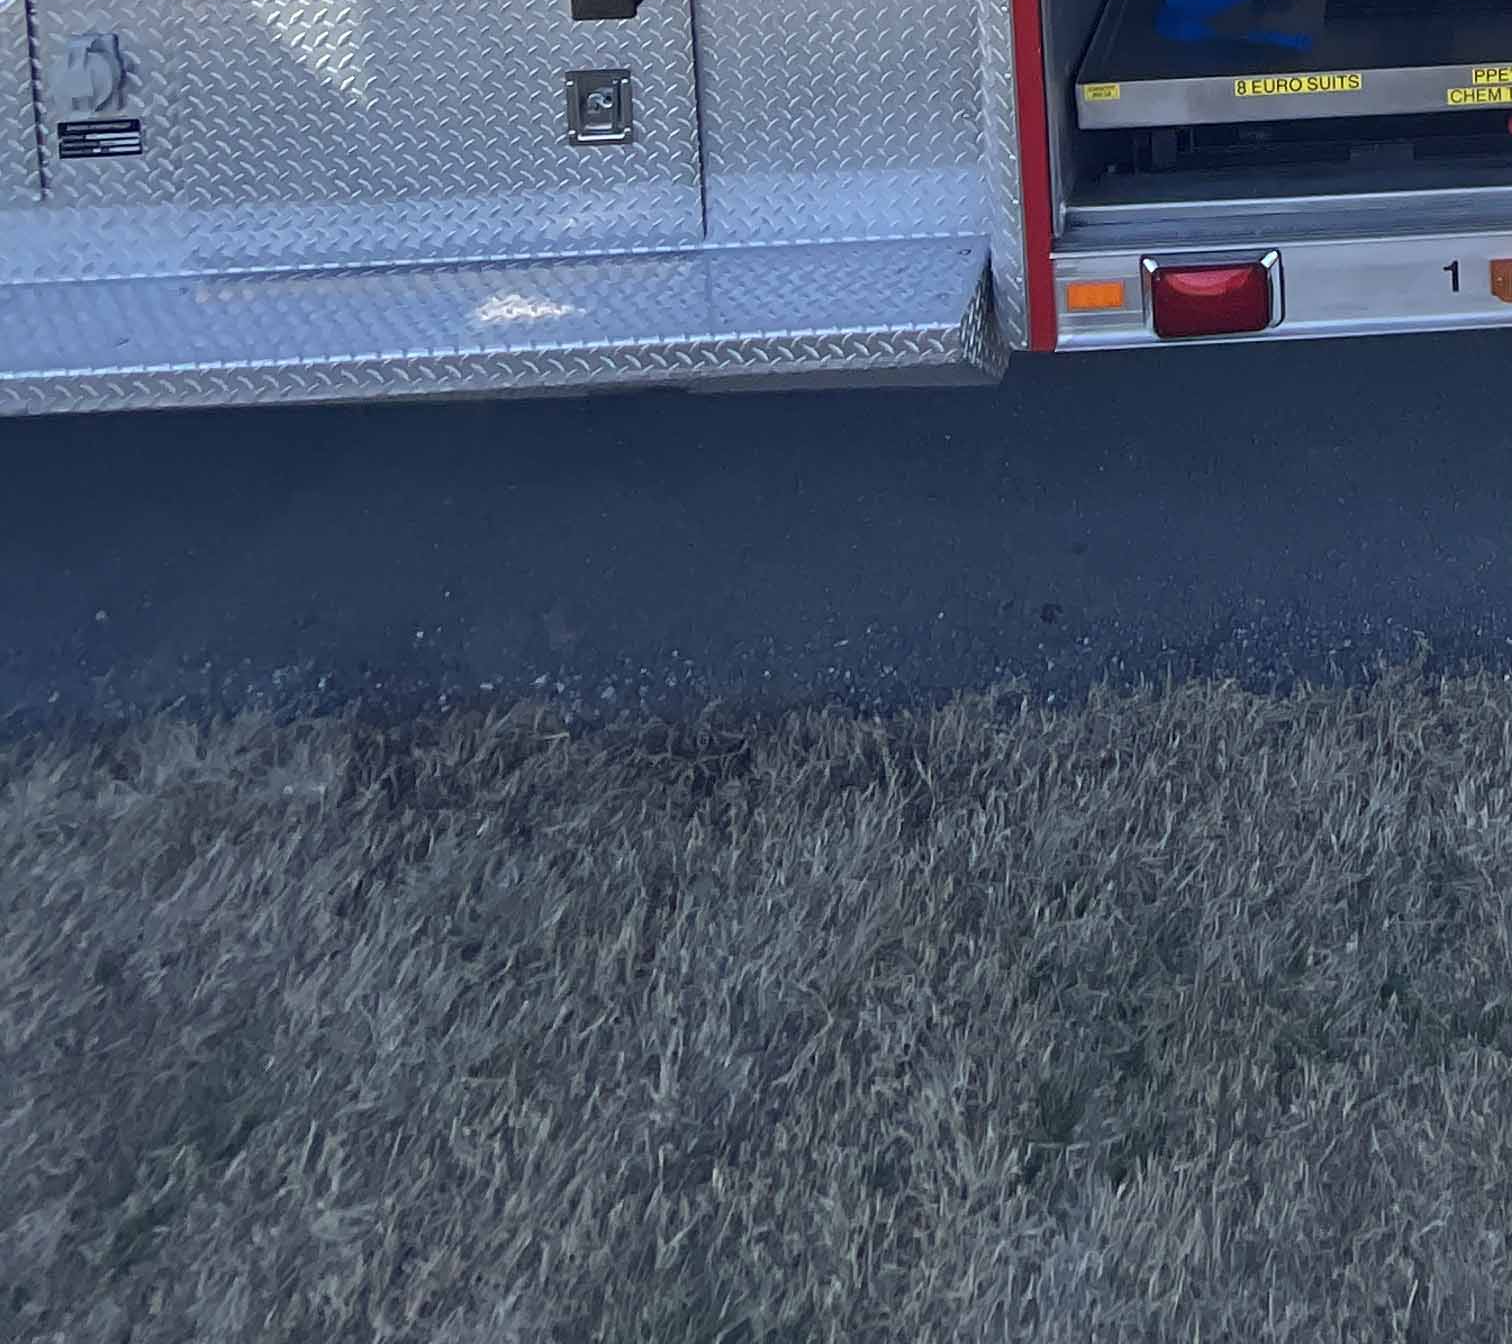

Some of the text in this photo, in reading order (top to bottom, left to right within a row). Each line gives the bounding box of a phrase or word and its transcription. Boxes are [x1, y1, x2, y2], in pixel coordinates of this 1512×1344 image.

[1236, 74, 1360, 95] 8 EURO SUITS
[1450, 88, 1502, 104] CHEM
[1442, 259, 1460, 293] 1
